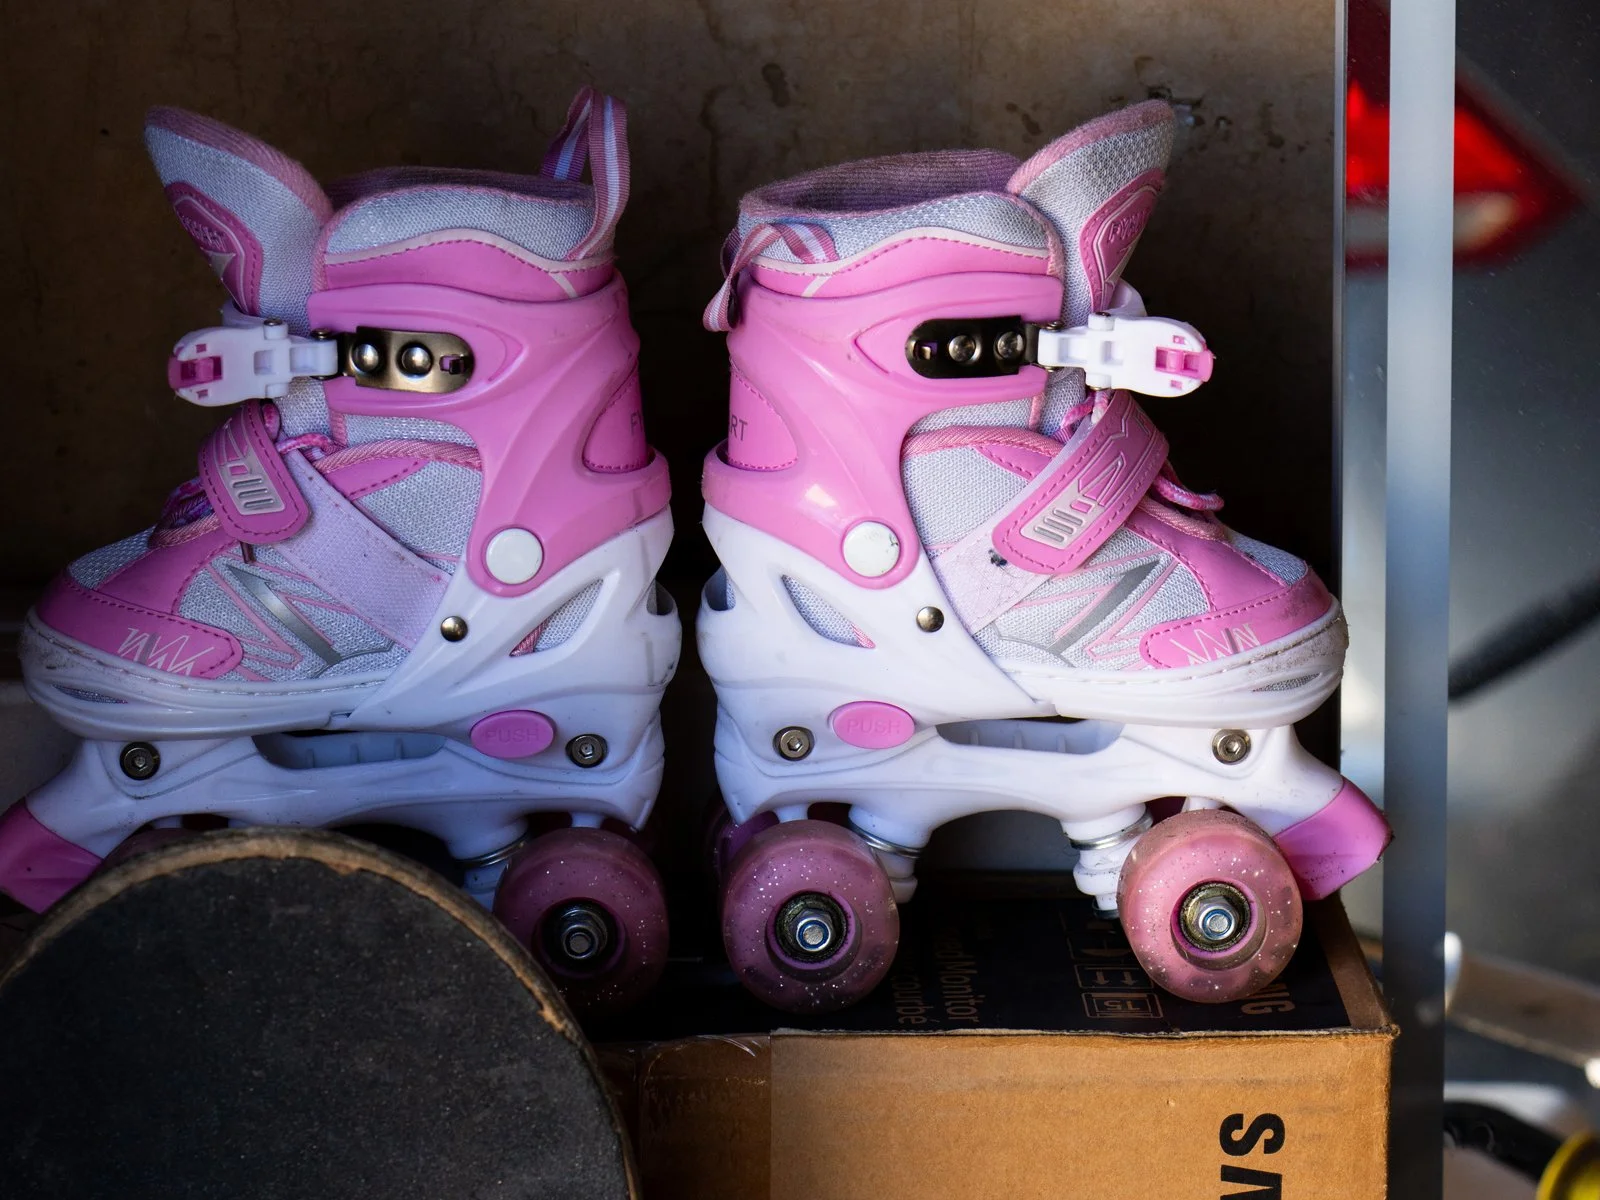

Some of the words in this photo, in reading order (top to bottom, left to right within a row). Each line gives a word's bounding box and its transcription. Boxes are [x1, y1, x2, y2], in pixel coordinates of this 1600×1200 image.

[483, 723, 541, 743] PUSH
[847, 717, 901, 736] PUSH
[936, 960, 987, 1025] Monitor
